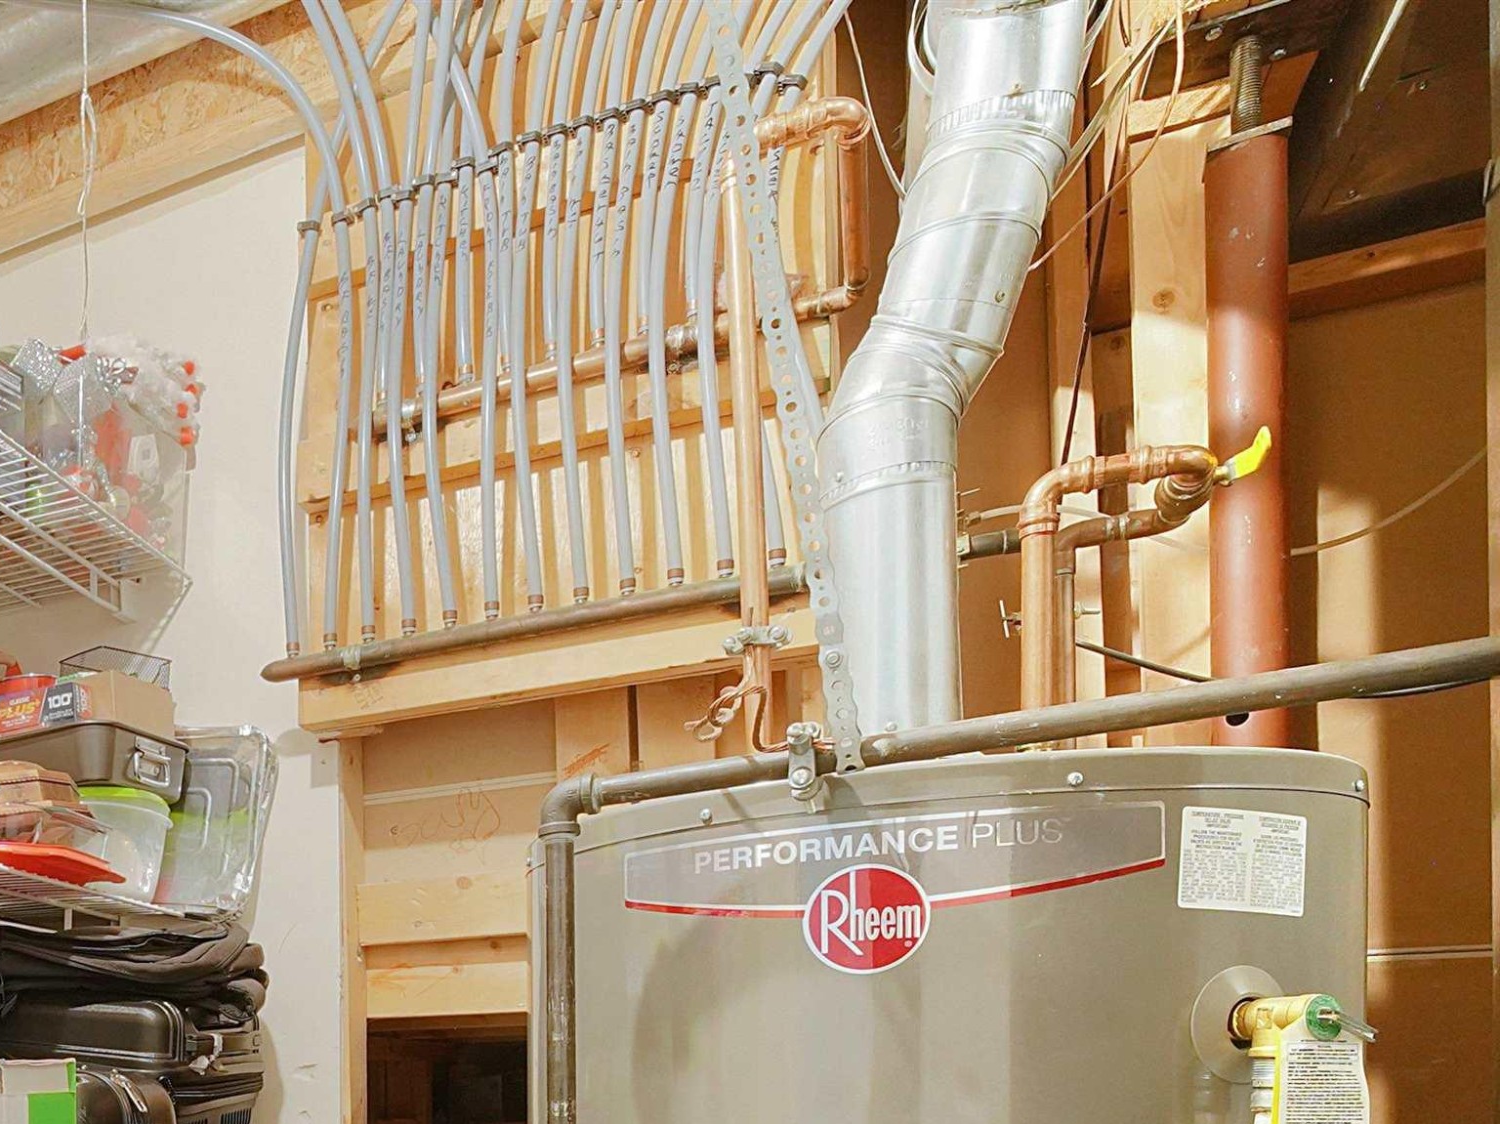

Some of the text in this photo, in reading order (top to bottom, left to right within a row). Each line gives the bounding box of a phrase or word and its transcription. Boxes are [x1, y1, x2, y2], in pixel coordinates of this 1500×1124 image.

[695, 818, 1063, 875] PERFORMANCE PLUS
[821, 871, 922, 955] Rheem
